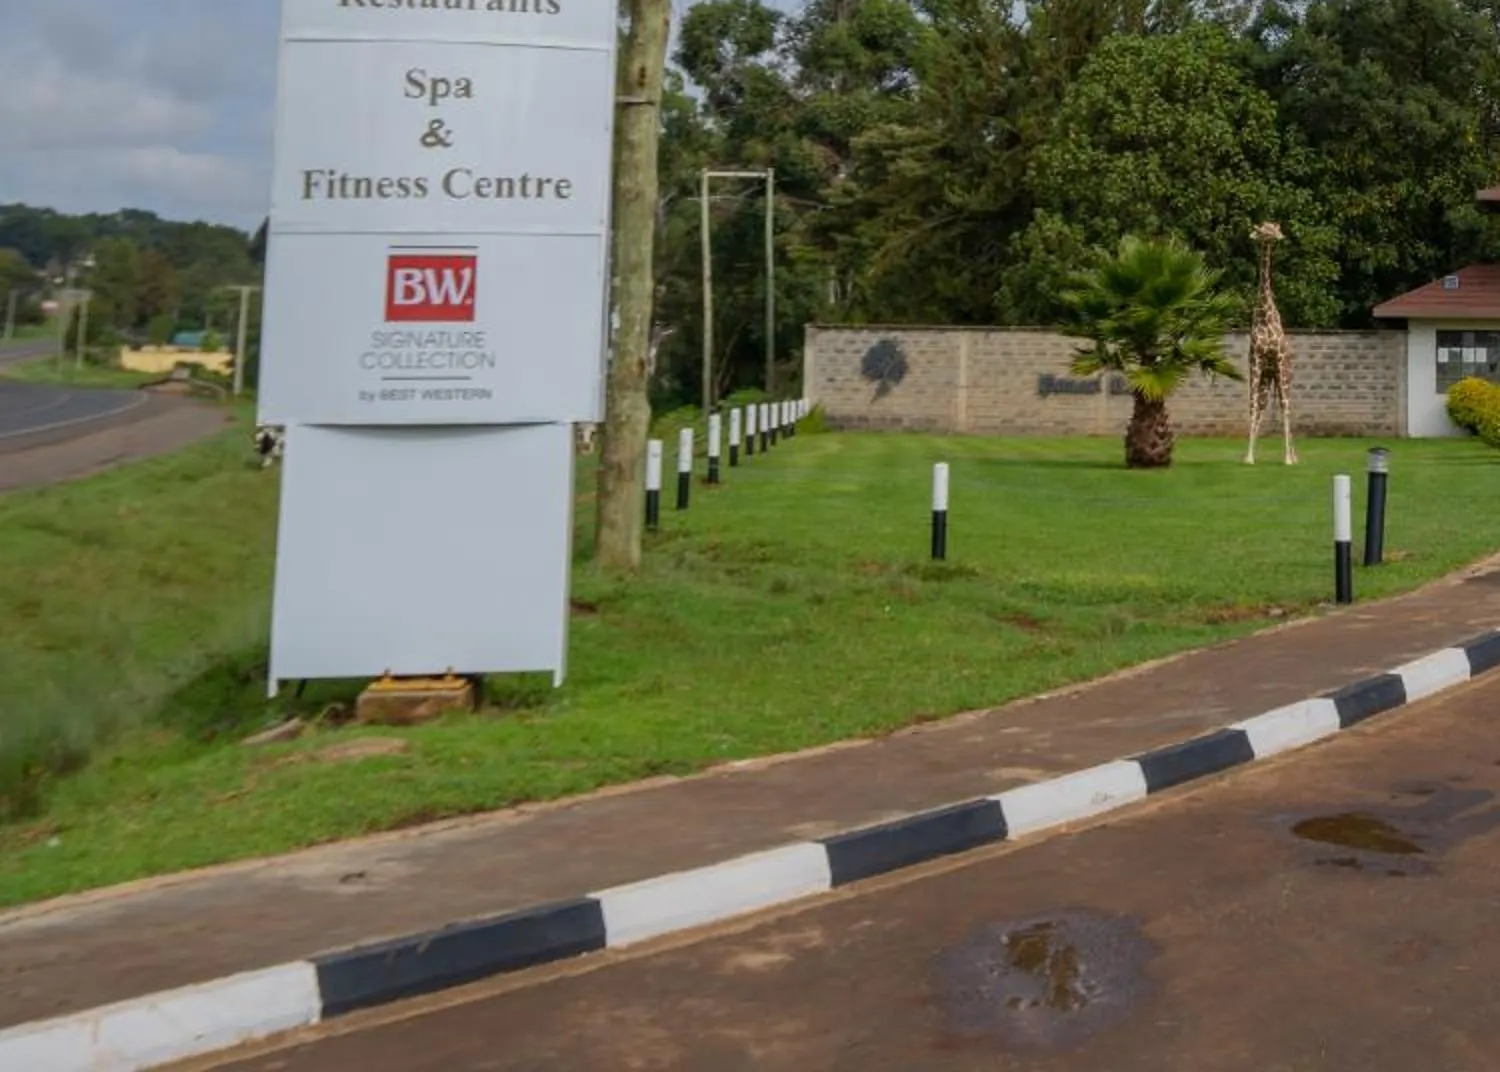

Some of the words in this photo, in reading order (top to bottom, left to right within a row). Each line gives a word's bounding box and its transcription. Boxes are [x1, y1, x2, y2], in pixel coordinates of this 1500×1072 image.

[404, 68, 474, 106] Spa
[420, 119, 453, 148] &
[302, 169, 428, 200] Fitness
[442, 168, 572, 200] Centre
[371, 331, 486, 348] SIGNATURE
[359, 351, 496, 368] COLLECTION
[379, 389, 416, 401] BEST
[422, 389, 493, 401] WESTERN
